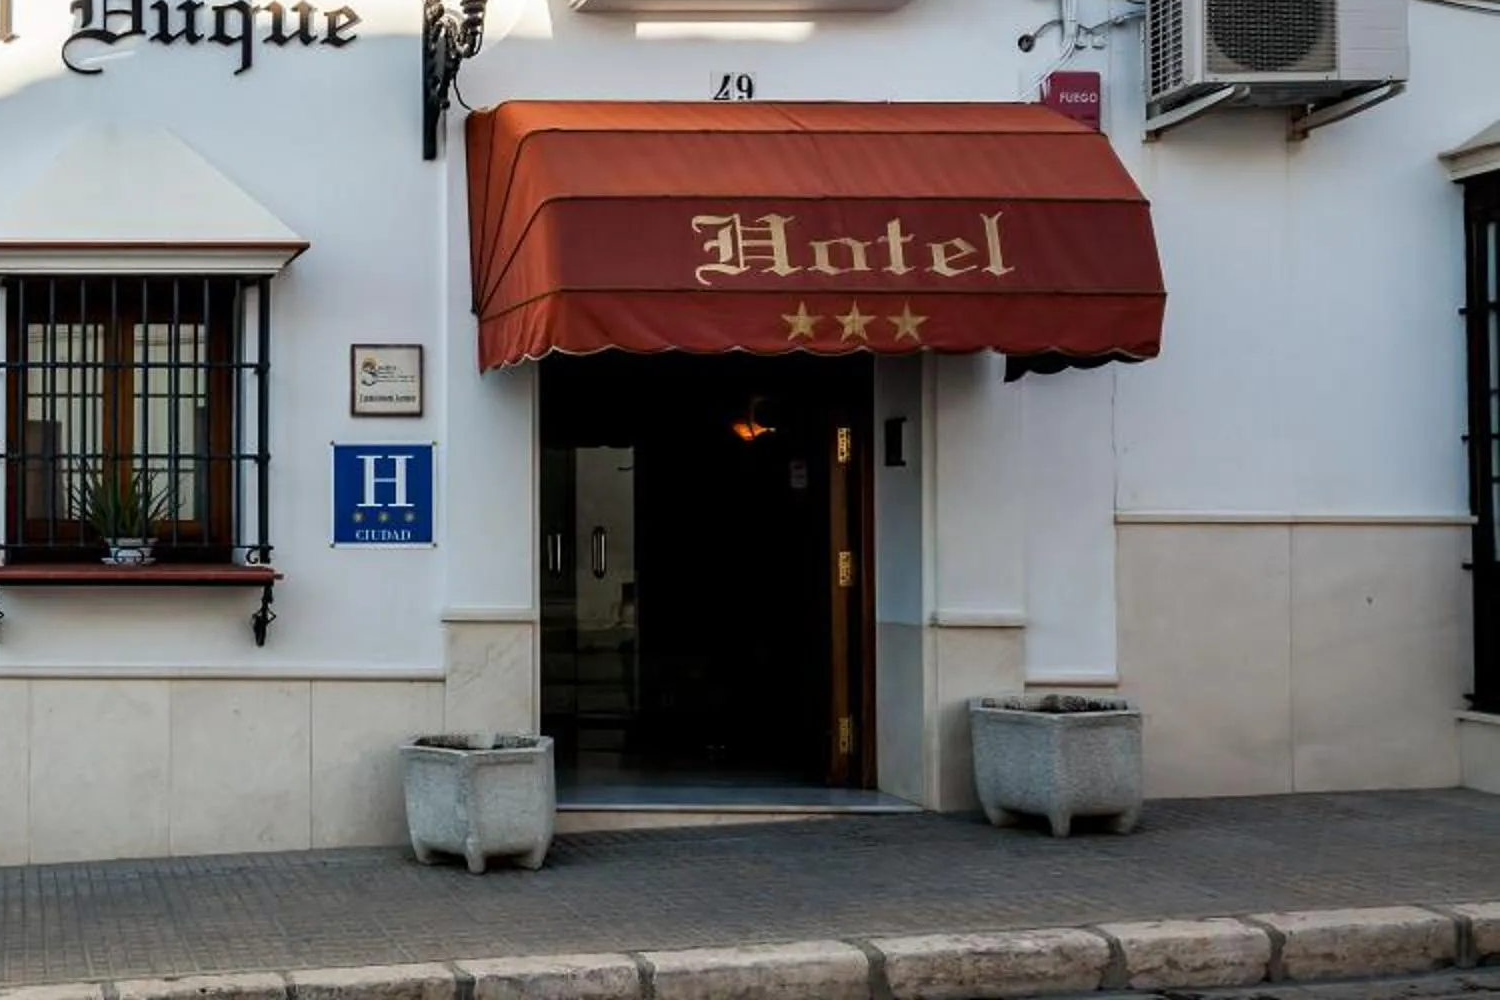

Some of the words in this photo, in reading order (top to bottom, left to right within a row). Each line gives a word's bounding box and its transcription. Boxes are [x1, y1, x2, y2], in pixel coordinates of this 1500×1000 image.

[713, 73, 753, 100] 49
[691, 210, 1016, 286] Hotel
[355, 454, 415, 508] H
[355, 529, 412, 541] CIUDAD
